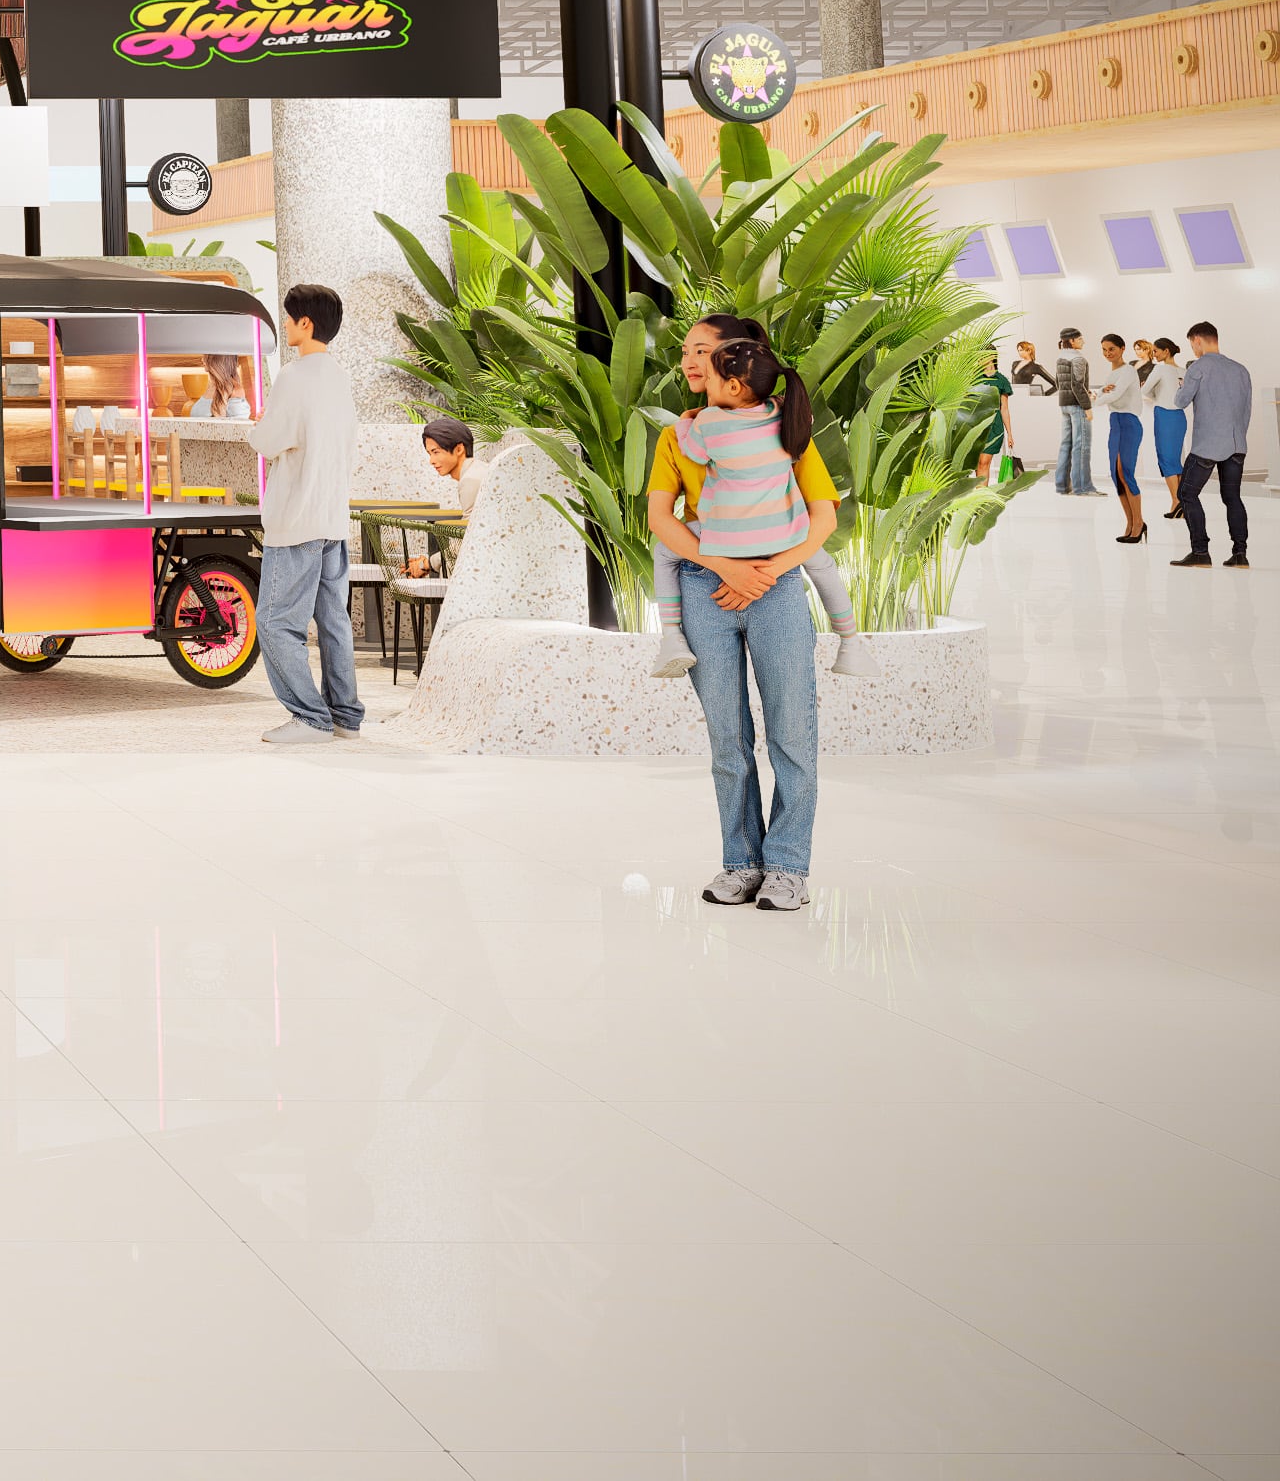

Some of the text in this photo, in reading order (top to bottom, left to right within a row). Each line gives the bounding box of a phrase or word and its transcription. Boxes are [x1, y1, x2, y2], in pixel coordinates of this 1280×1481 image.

[262, 29, 392, 47] CAFÉ URBANO
[709, 33, 788, 75] EL JAGUAR
[743, 87, 784, 114] URBANO
